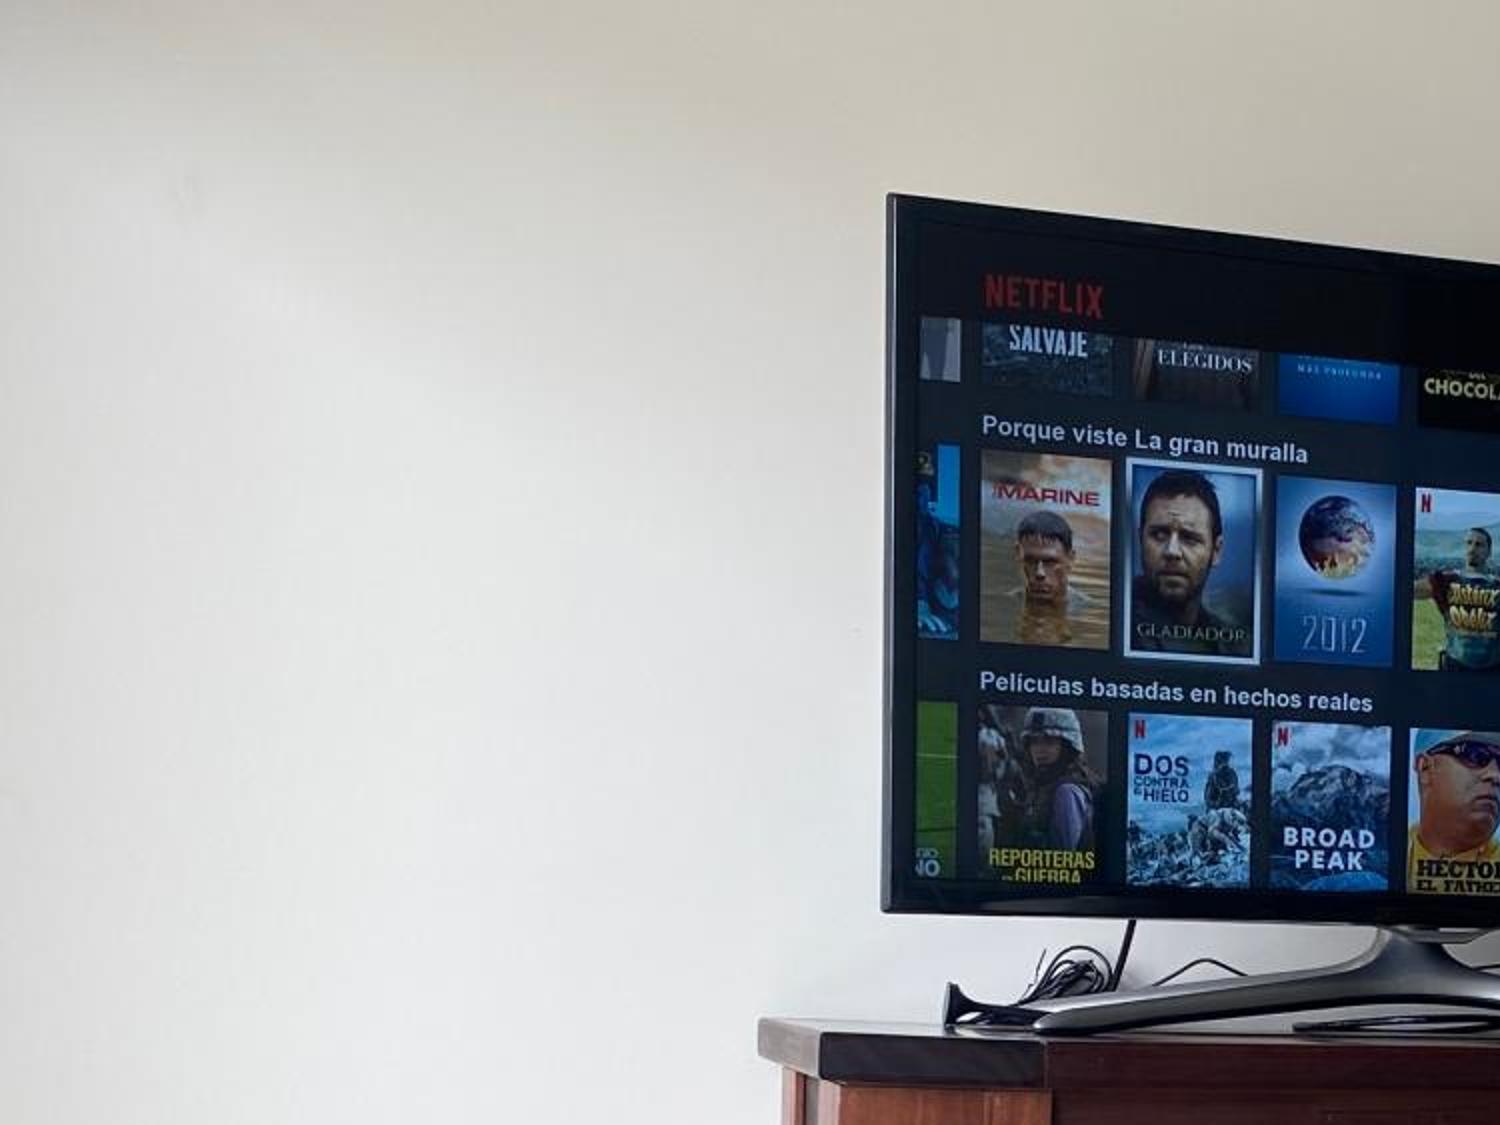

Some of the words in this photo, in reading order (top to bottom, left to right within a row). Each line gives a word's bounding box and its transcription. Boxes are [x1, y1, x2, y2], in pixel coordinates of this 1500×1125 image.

[984, 273, 1104, 320] NETFLIX
[1008, 323, 1089, 357] SALVAJE
[1158, 349, 1254, 373] ELEGIDOS
[982, 415, 1066, 445] Porque
[1072, 424, 1128, 447] viste
[1134, 429, 1162, 450] La
[1169, 436, 1219, 457] gran
[1226, 441, 1309, 464] muralla
[997, 484, 1100, 507] MARINE
[1420, 493, 1432, 513] N
[1136, 623, 1248, 641] GLADIADOR
[1302, 615, 1368, 654] 2012
[980, 671, 1084, 697] Películas
[1090, 677, 1184, 702] basadas
[1190, 686, 1217, 705] en
[1223, 686, 1302, 709] hechos
[1308, 692, 1374, 713] reales
[1134, 719, 1146, 739] N
[1276, 726, 1289, 747] N
[1134, 753, 1189, 777] DOS
[1134, 775, 1190, 789] CONTRA
[1143, 788, 1190, 803] HIELO
[1283, 826, 1375, 849] BROAD
[989, 848, 1096, 870] REPORTERAS
[1294, 849, 1364, 871] PEAK
[1015, 867, 1081, 884] GUERRA
[1416, 880, 1437, 892] EL
